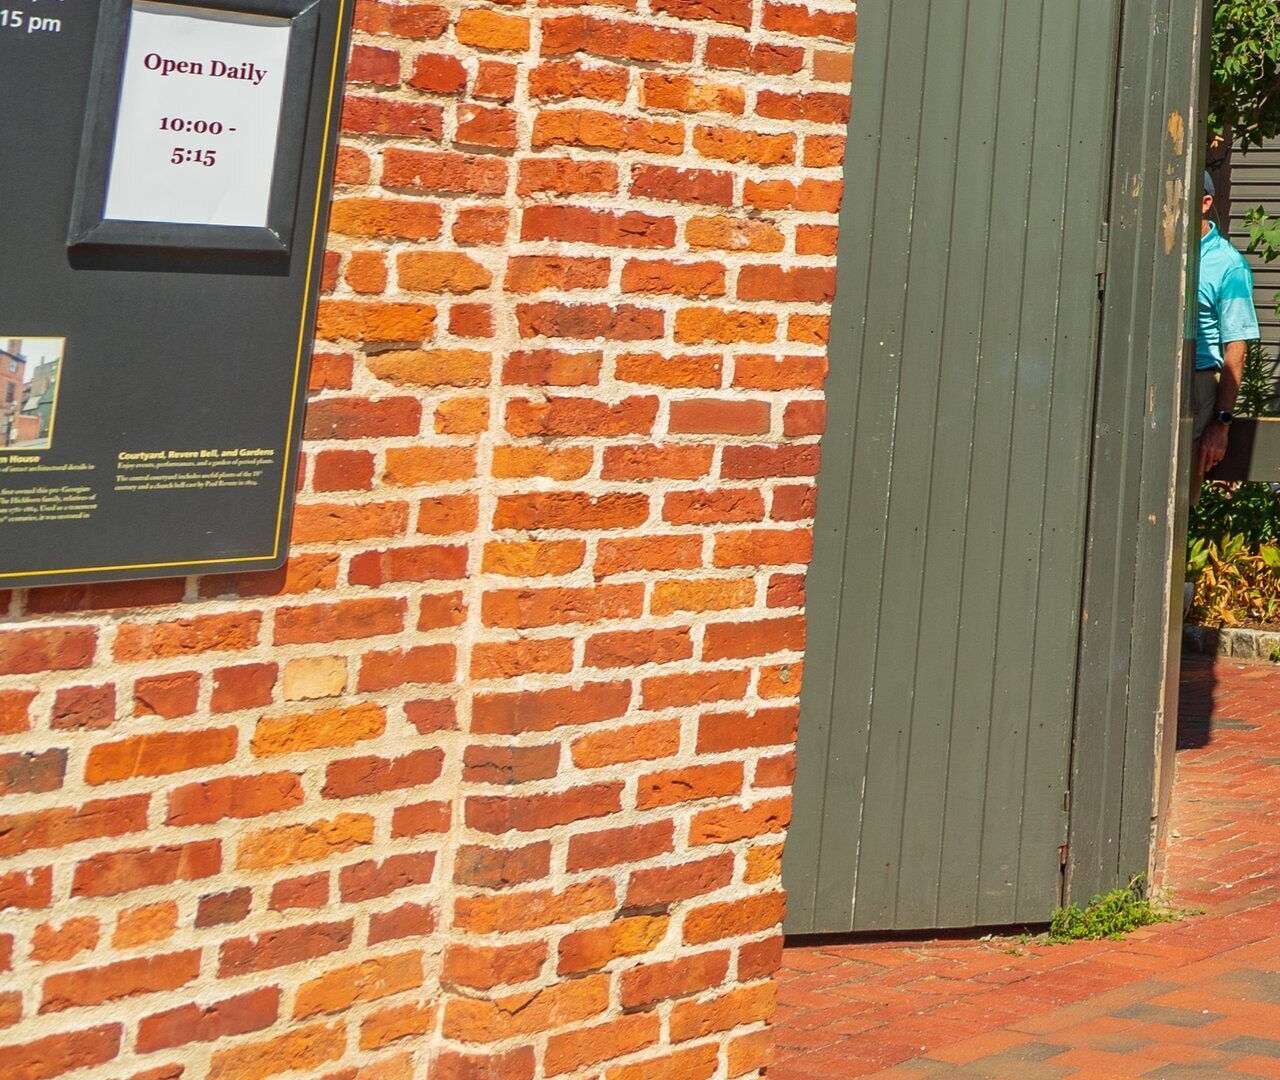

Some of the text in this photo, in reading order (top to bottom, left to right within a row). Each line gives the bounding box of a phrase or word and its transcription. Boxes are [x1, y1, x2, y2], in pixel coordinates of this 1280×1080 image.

[28, 16, 61, 33] pm
[144, 53, 268, 85] Open Daily
[159, 117, 223, 135] 10:00
[171, 147, 216, 167] 5:15
[118, 450, 166, 461] Courtyard,
[168, 450, 199, 459] Revere
[221, 448, 238, 457] and
[239, 448, 274, 457] Gardens
